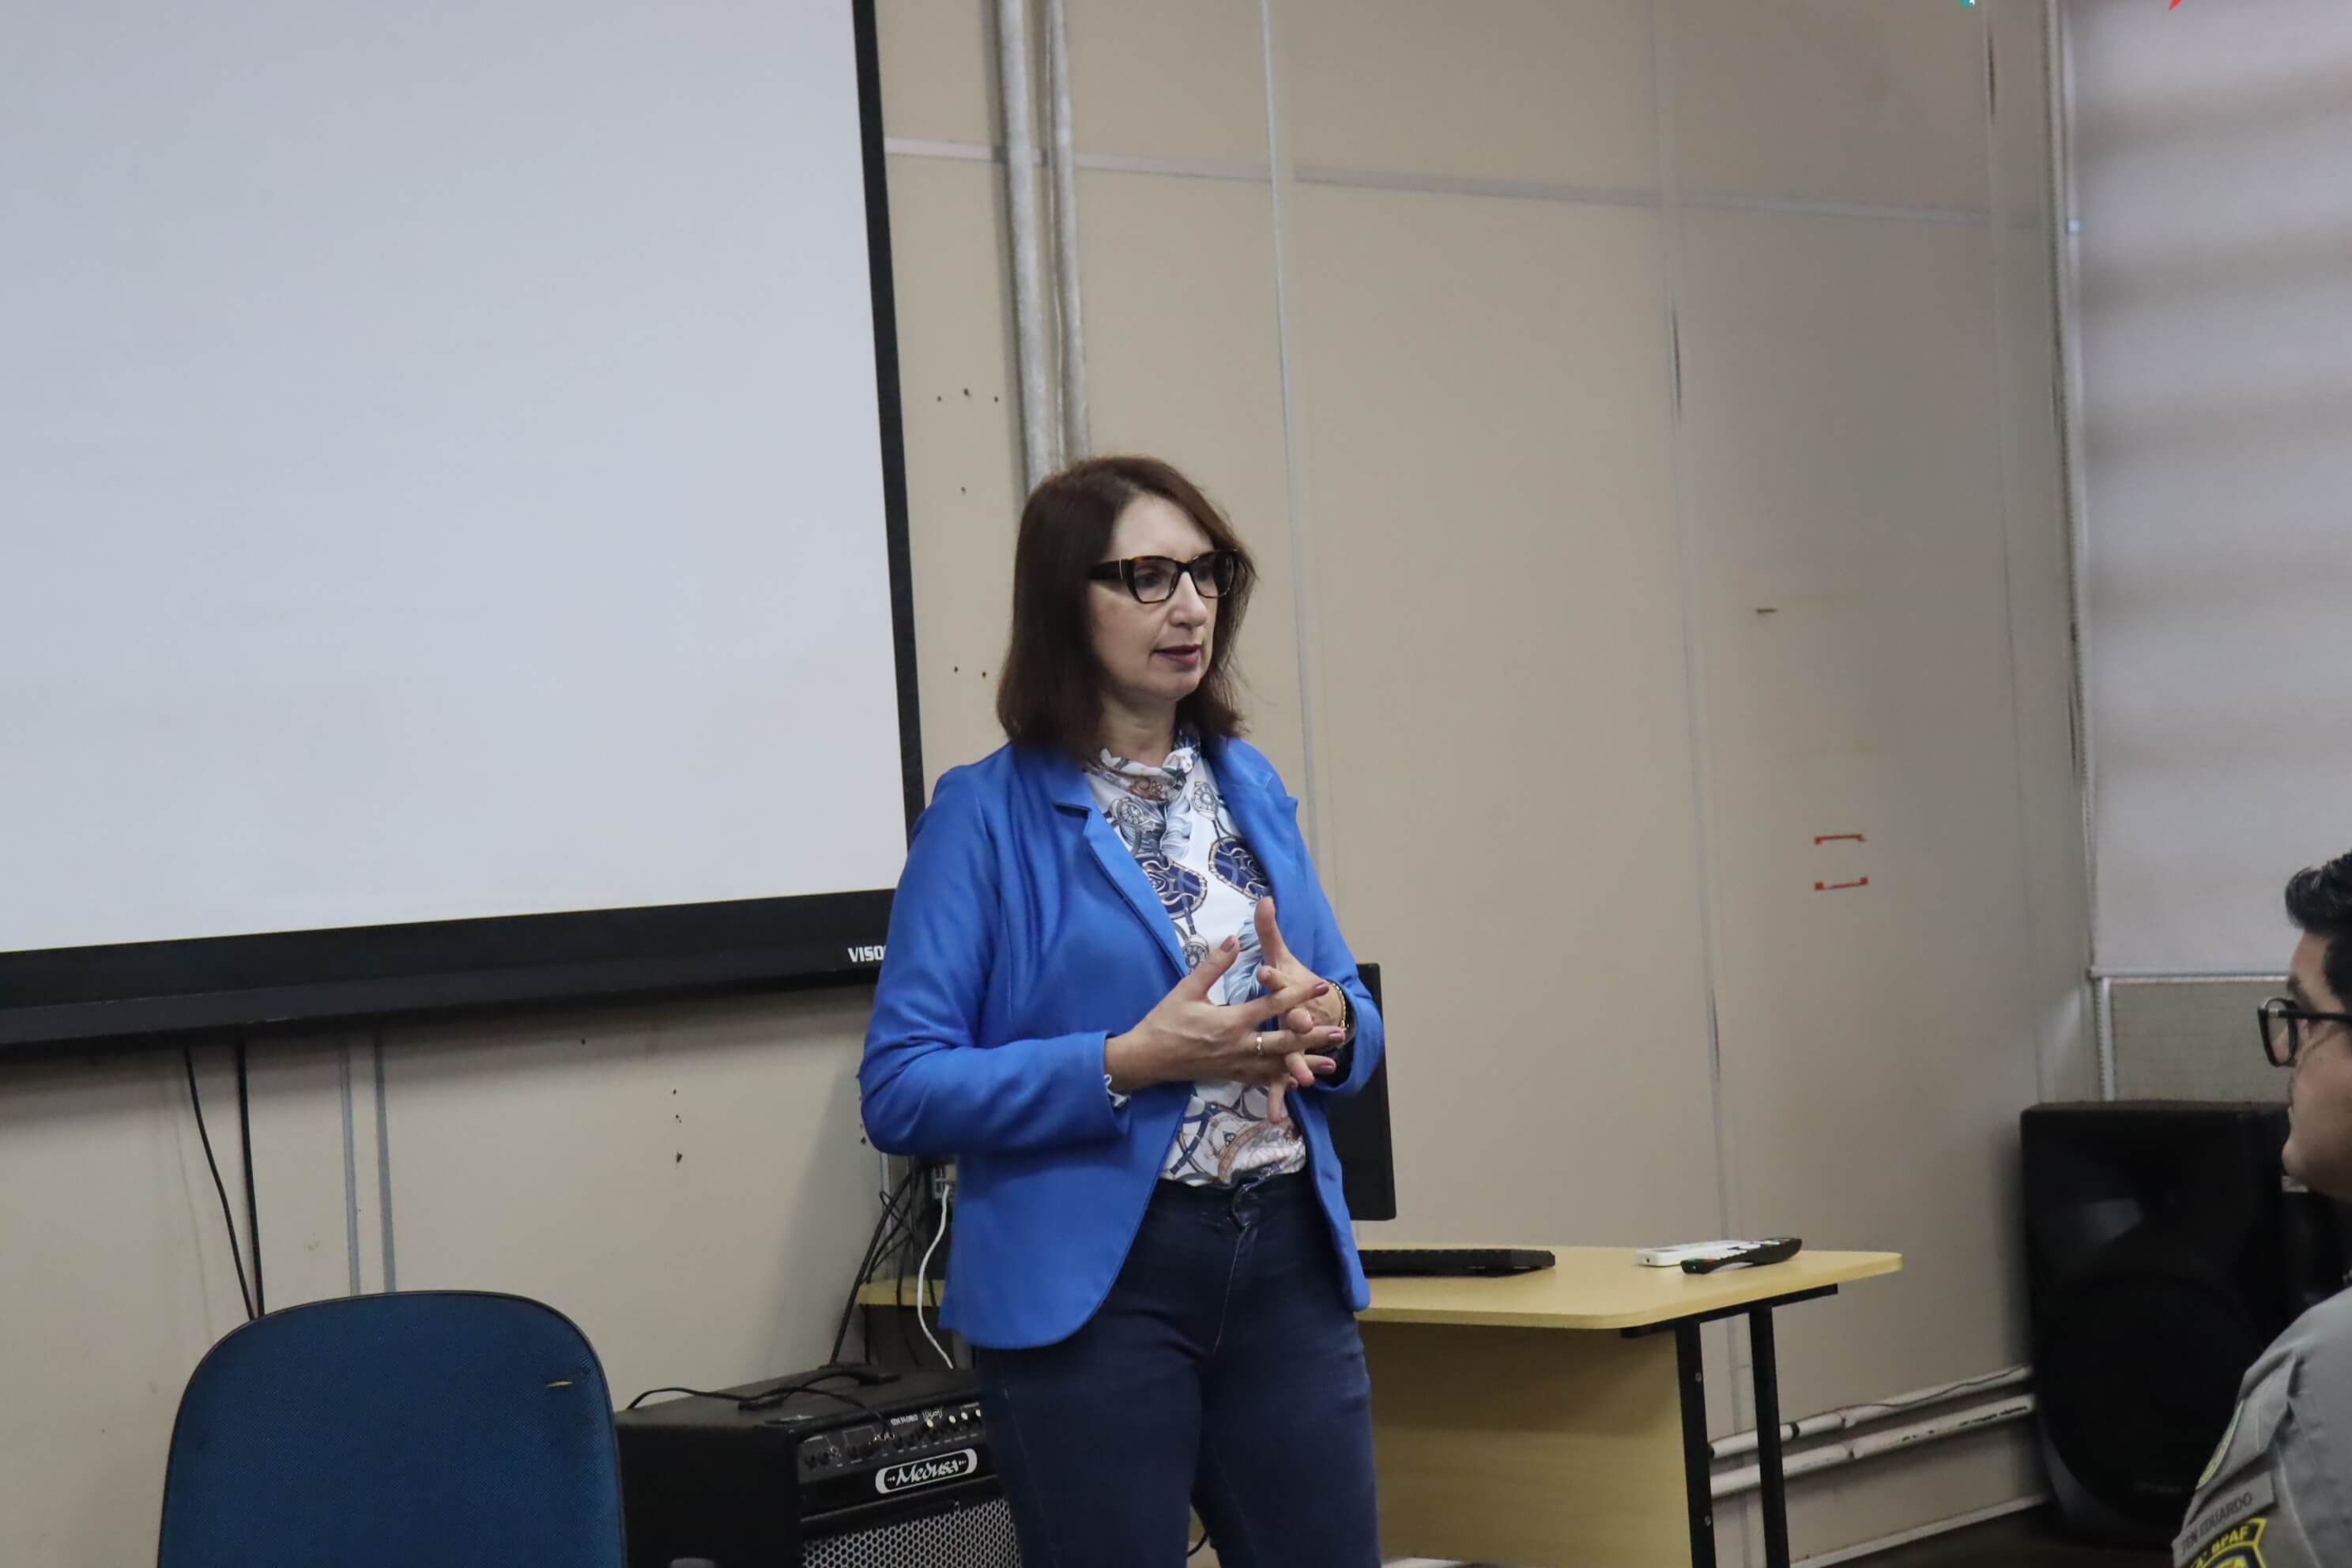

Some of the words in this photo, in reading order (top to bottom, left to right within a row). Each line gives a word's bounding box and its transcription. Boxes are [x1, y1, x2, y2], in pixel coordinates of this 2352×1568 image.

[848, 945, 886, 963] VISO
[896, 1459, 959, 1487] Medusa
[2199, 1492, 2252, 1536] EDUARDO
